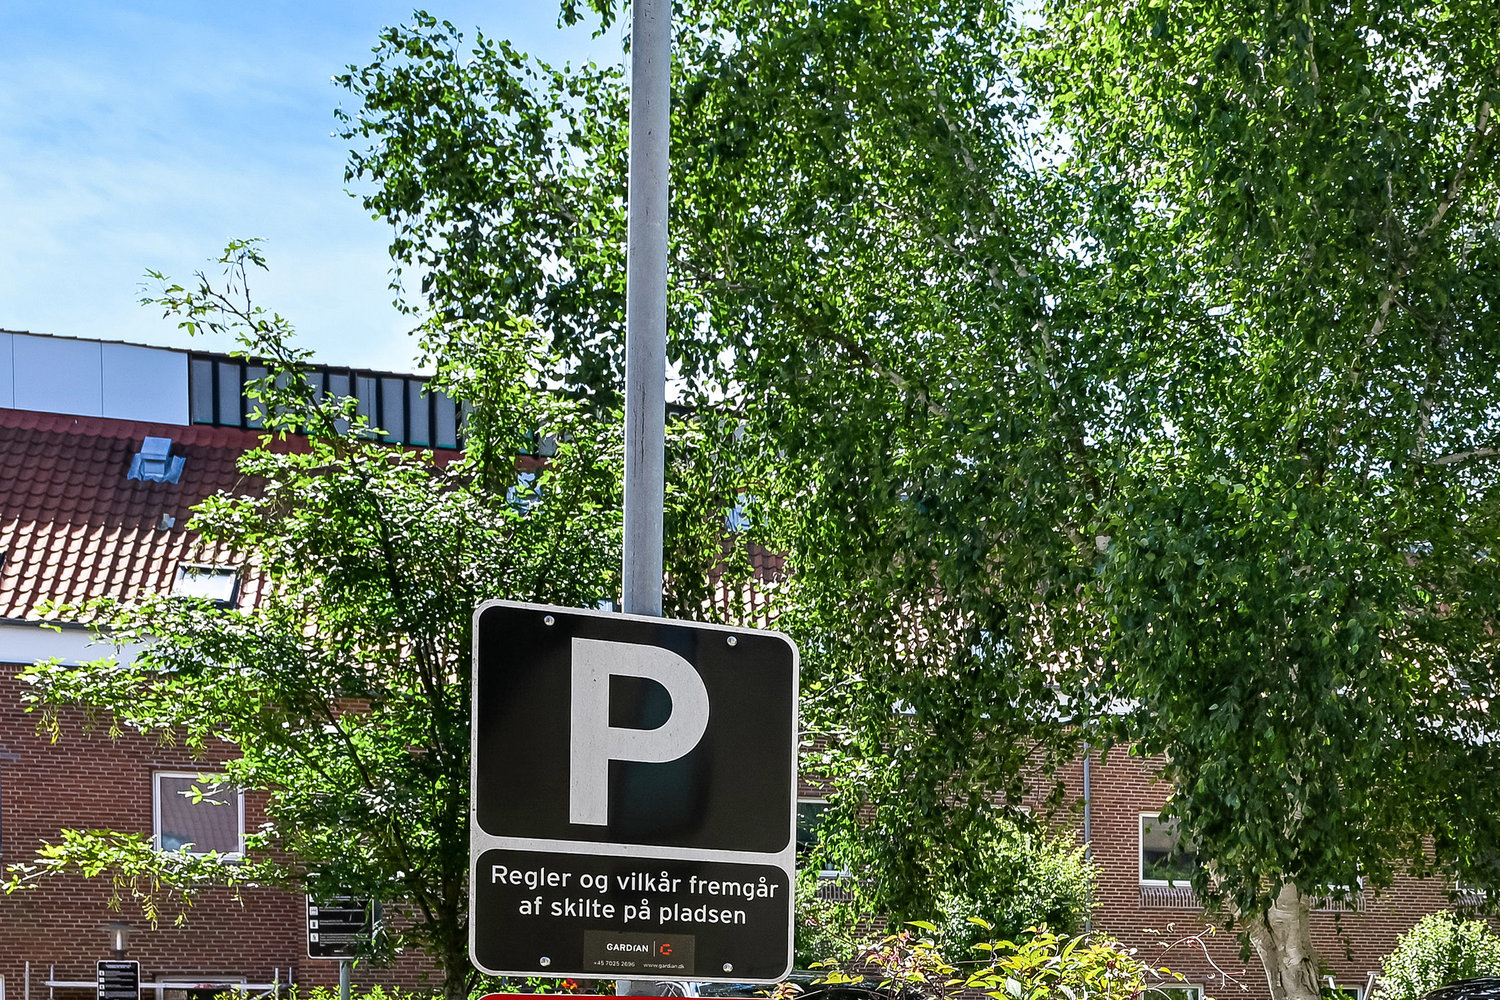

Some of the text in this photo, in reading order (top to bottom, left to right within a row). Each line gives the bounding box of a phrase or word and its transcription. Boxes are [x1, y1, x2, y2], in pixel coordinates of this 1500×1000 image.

[570, 637, 710, 826] P
[491, 864, 779, 901] Regler og vilkår fremgår
[518, 896, 747, 925] af skilte på pladsen
